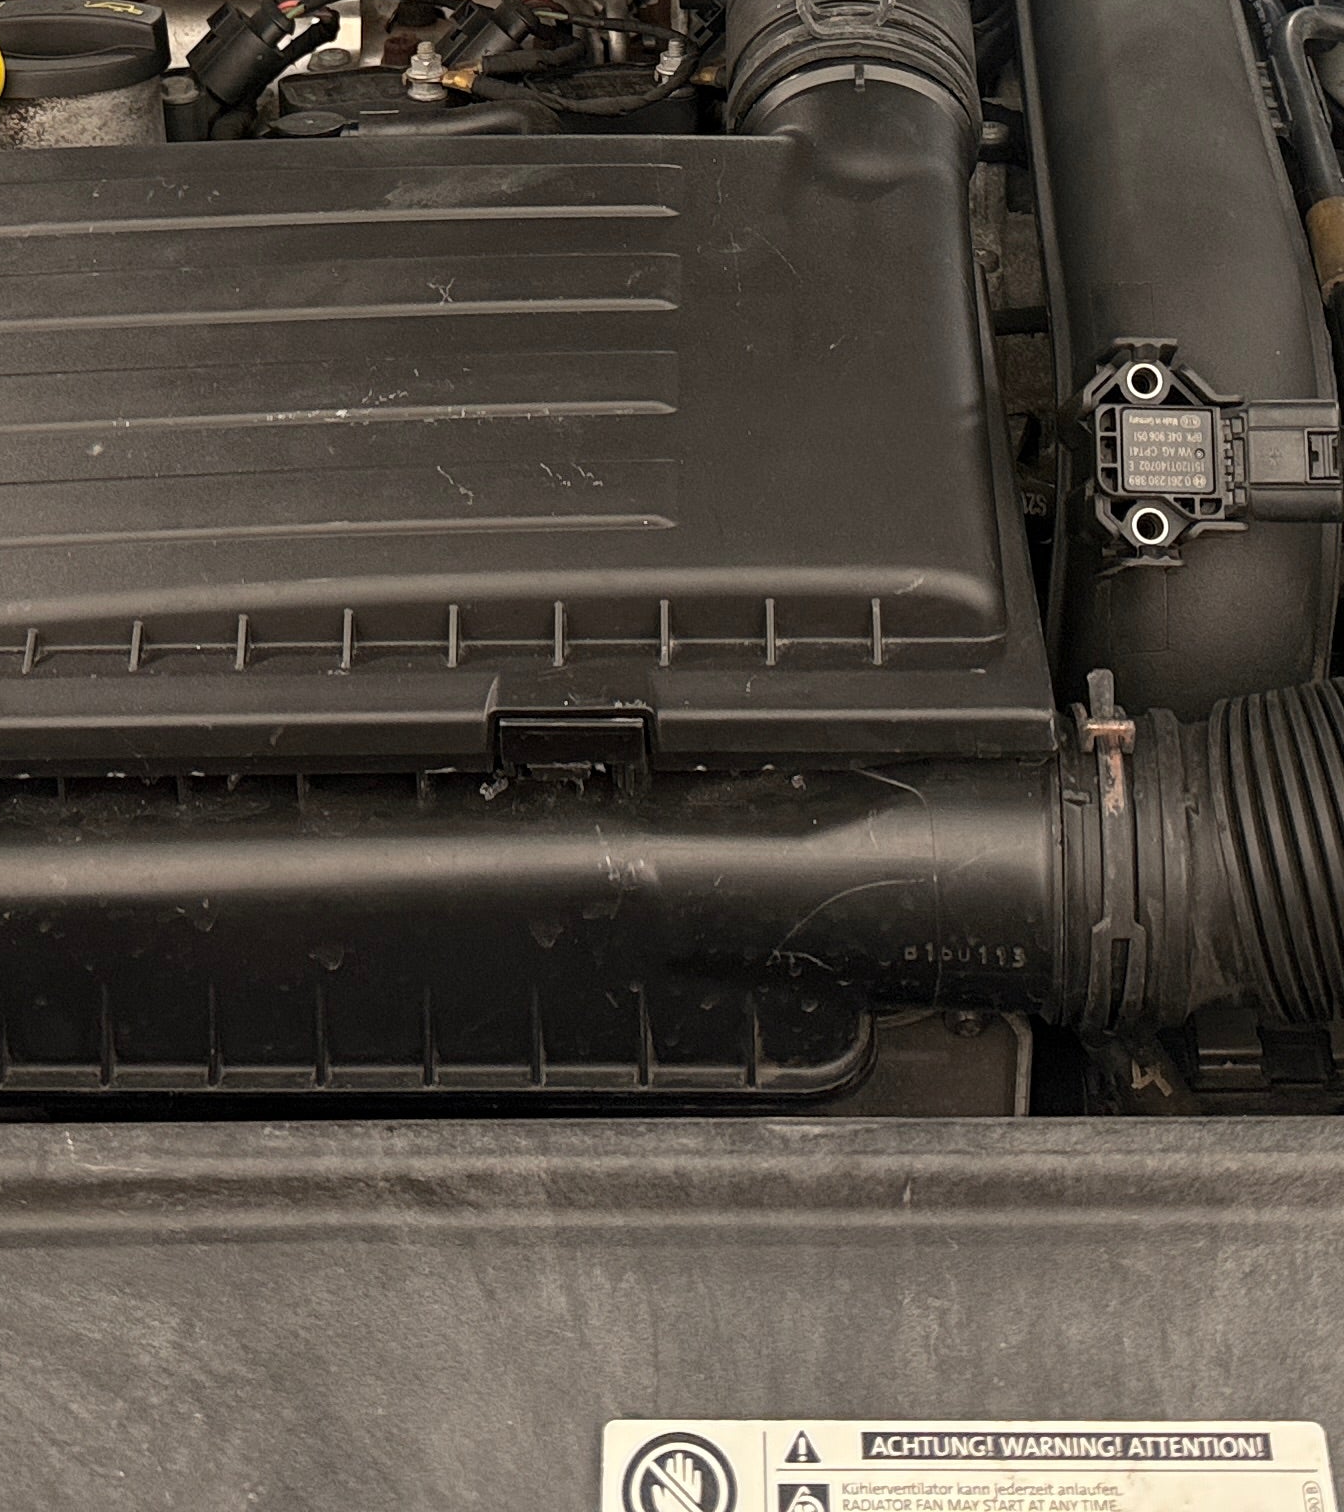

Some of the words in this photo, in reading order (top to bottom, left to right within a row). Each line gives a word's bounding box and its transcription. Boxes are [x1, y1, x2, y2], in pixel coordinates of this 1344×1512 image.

[1162, 447, 1175, 456] AG
[871, 1436, 995, 1457] ACHTUNG!
[1001, 1436, 1122, 1457] WARNING!
[1128, 1436, 1265, 1457] ATTENTION!
[956, 1482, 990, 1495] kann
[993, 1482, 1054, 1498] jederzeit
[842, 1499, 913, 1512] RADIATOR
[917, 1499, 944, 1512] FAN
[947, 1499, 980, 1512] MAY
[983, 1499, 1023, 1512] START
[1028, 1499, 1046, 1512] AT
[1050, 1499, 1079, 1512] ANY
